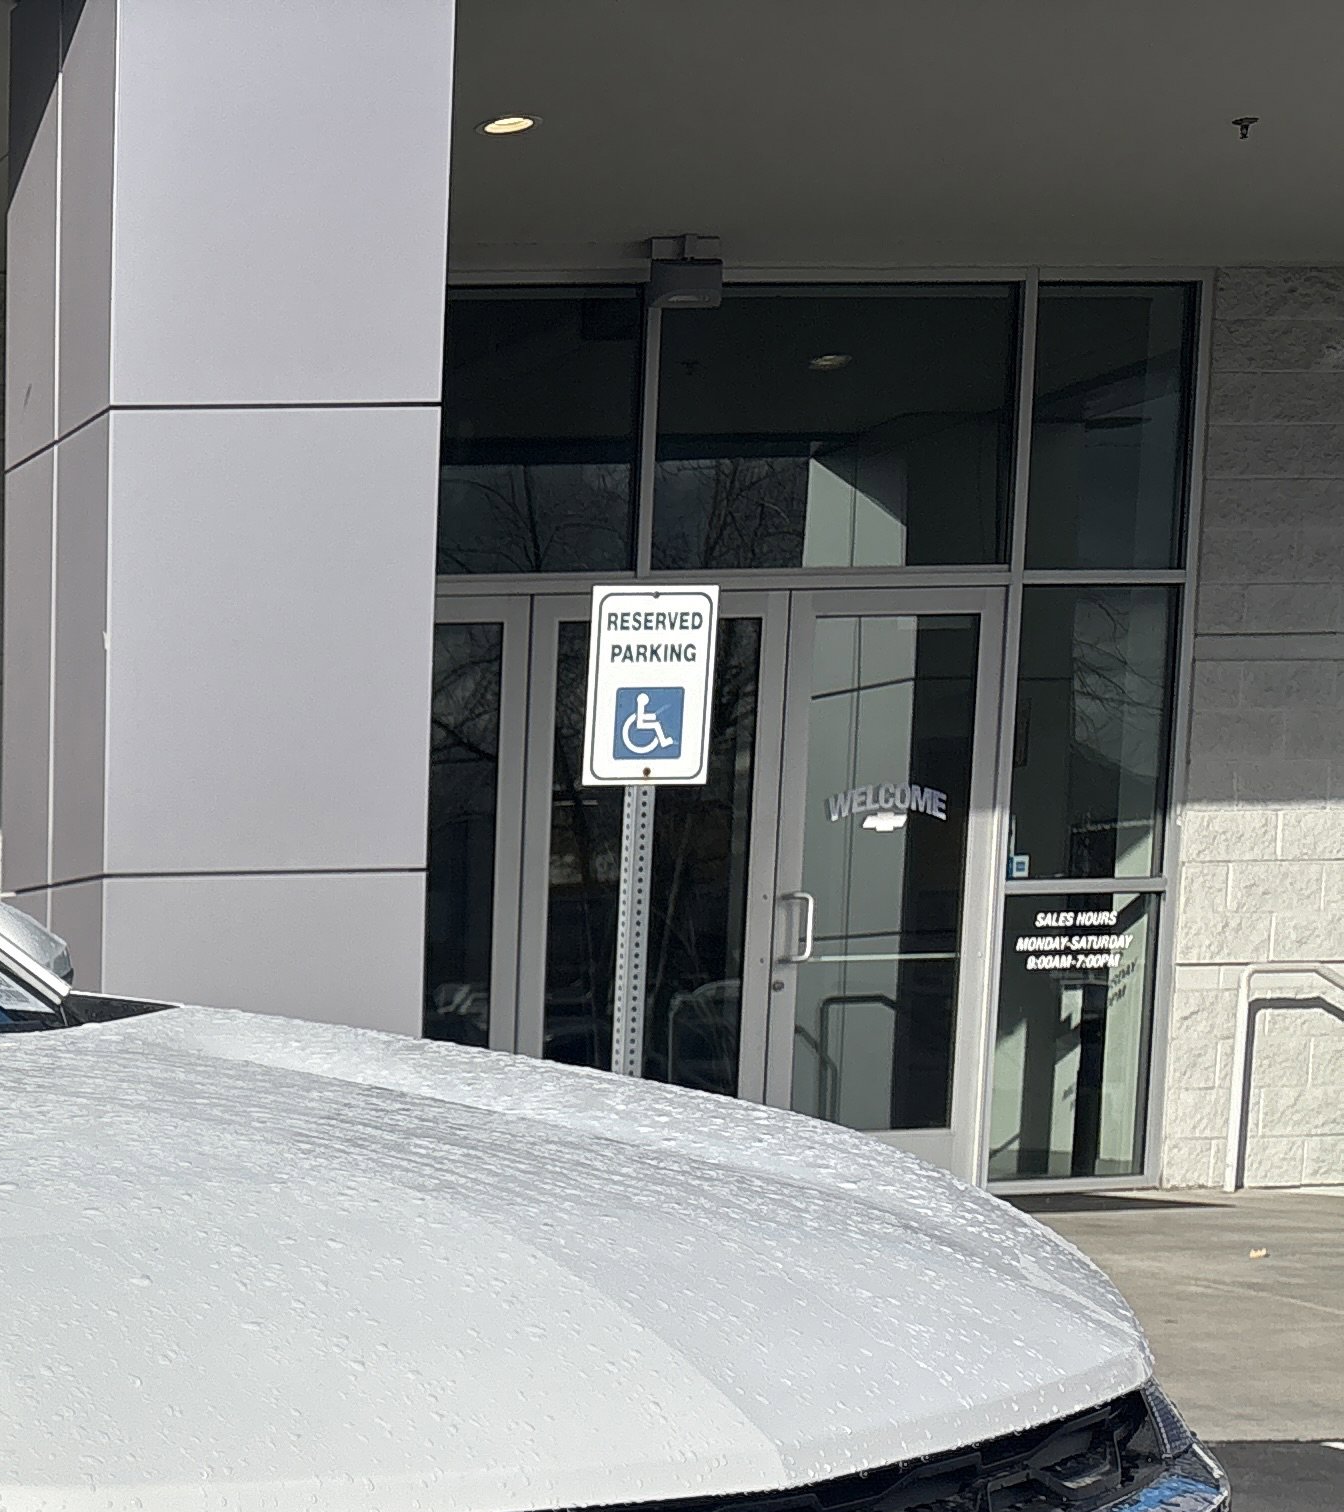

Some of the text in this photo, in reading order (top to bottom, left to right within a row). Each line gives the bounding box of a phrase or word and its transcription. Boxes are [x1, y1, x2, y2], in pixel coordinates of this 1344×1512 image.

[607, 612, 703, 631] RESERVED
[611, 643, 697, 663] PARKING
[828, 784, 947, 822] WELCOME
[1035, 911, 1118, 927] SALES HOURS
[1016, 935, 1133, 951] MONDAY-SATURDAY
